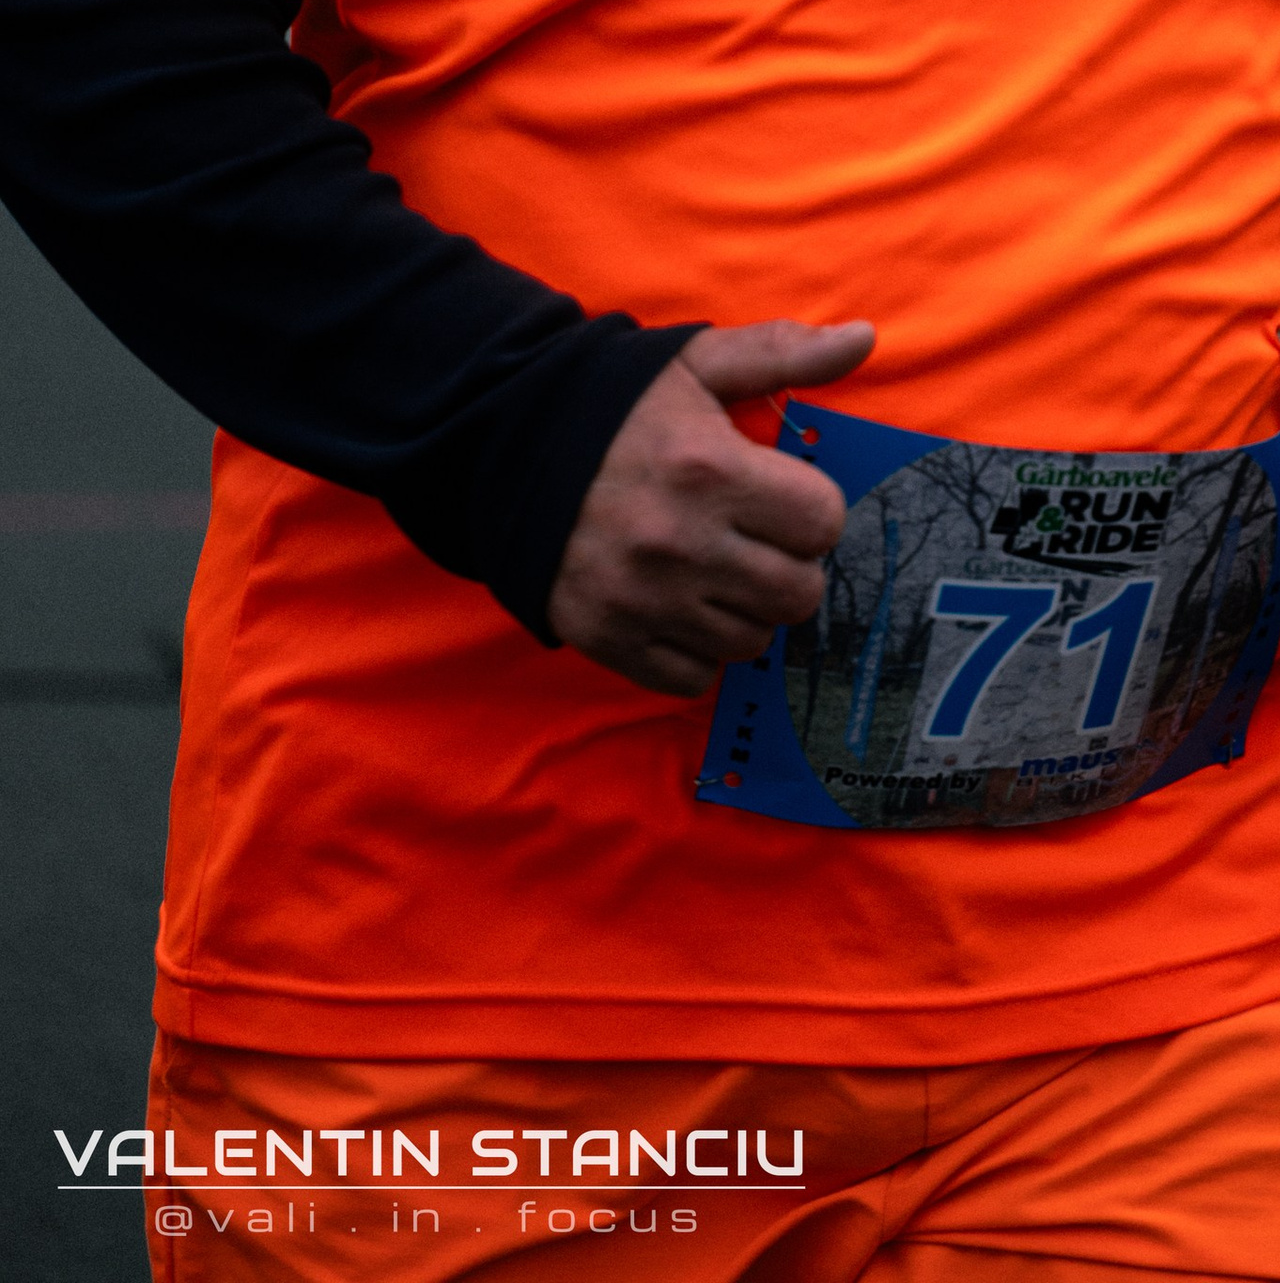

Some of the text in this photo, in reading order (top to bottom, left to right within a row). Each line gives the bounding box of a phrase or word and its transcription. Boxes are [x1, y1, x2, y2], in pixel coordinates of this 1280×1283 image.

[1061, 491, 1173, 522] RUN
[1047, 524, 1164, 554] RIDE
[926, 578, 1161, 738] 71
[1020, 749, 1120, 776] maus
[824, 766, 982, 792] Powered by
